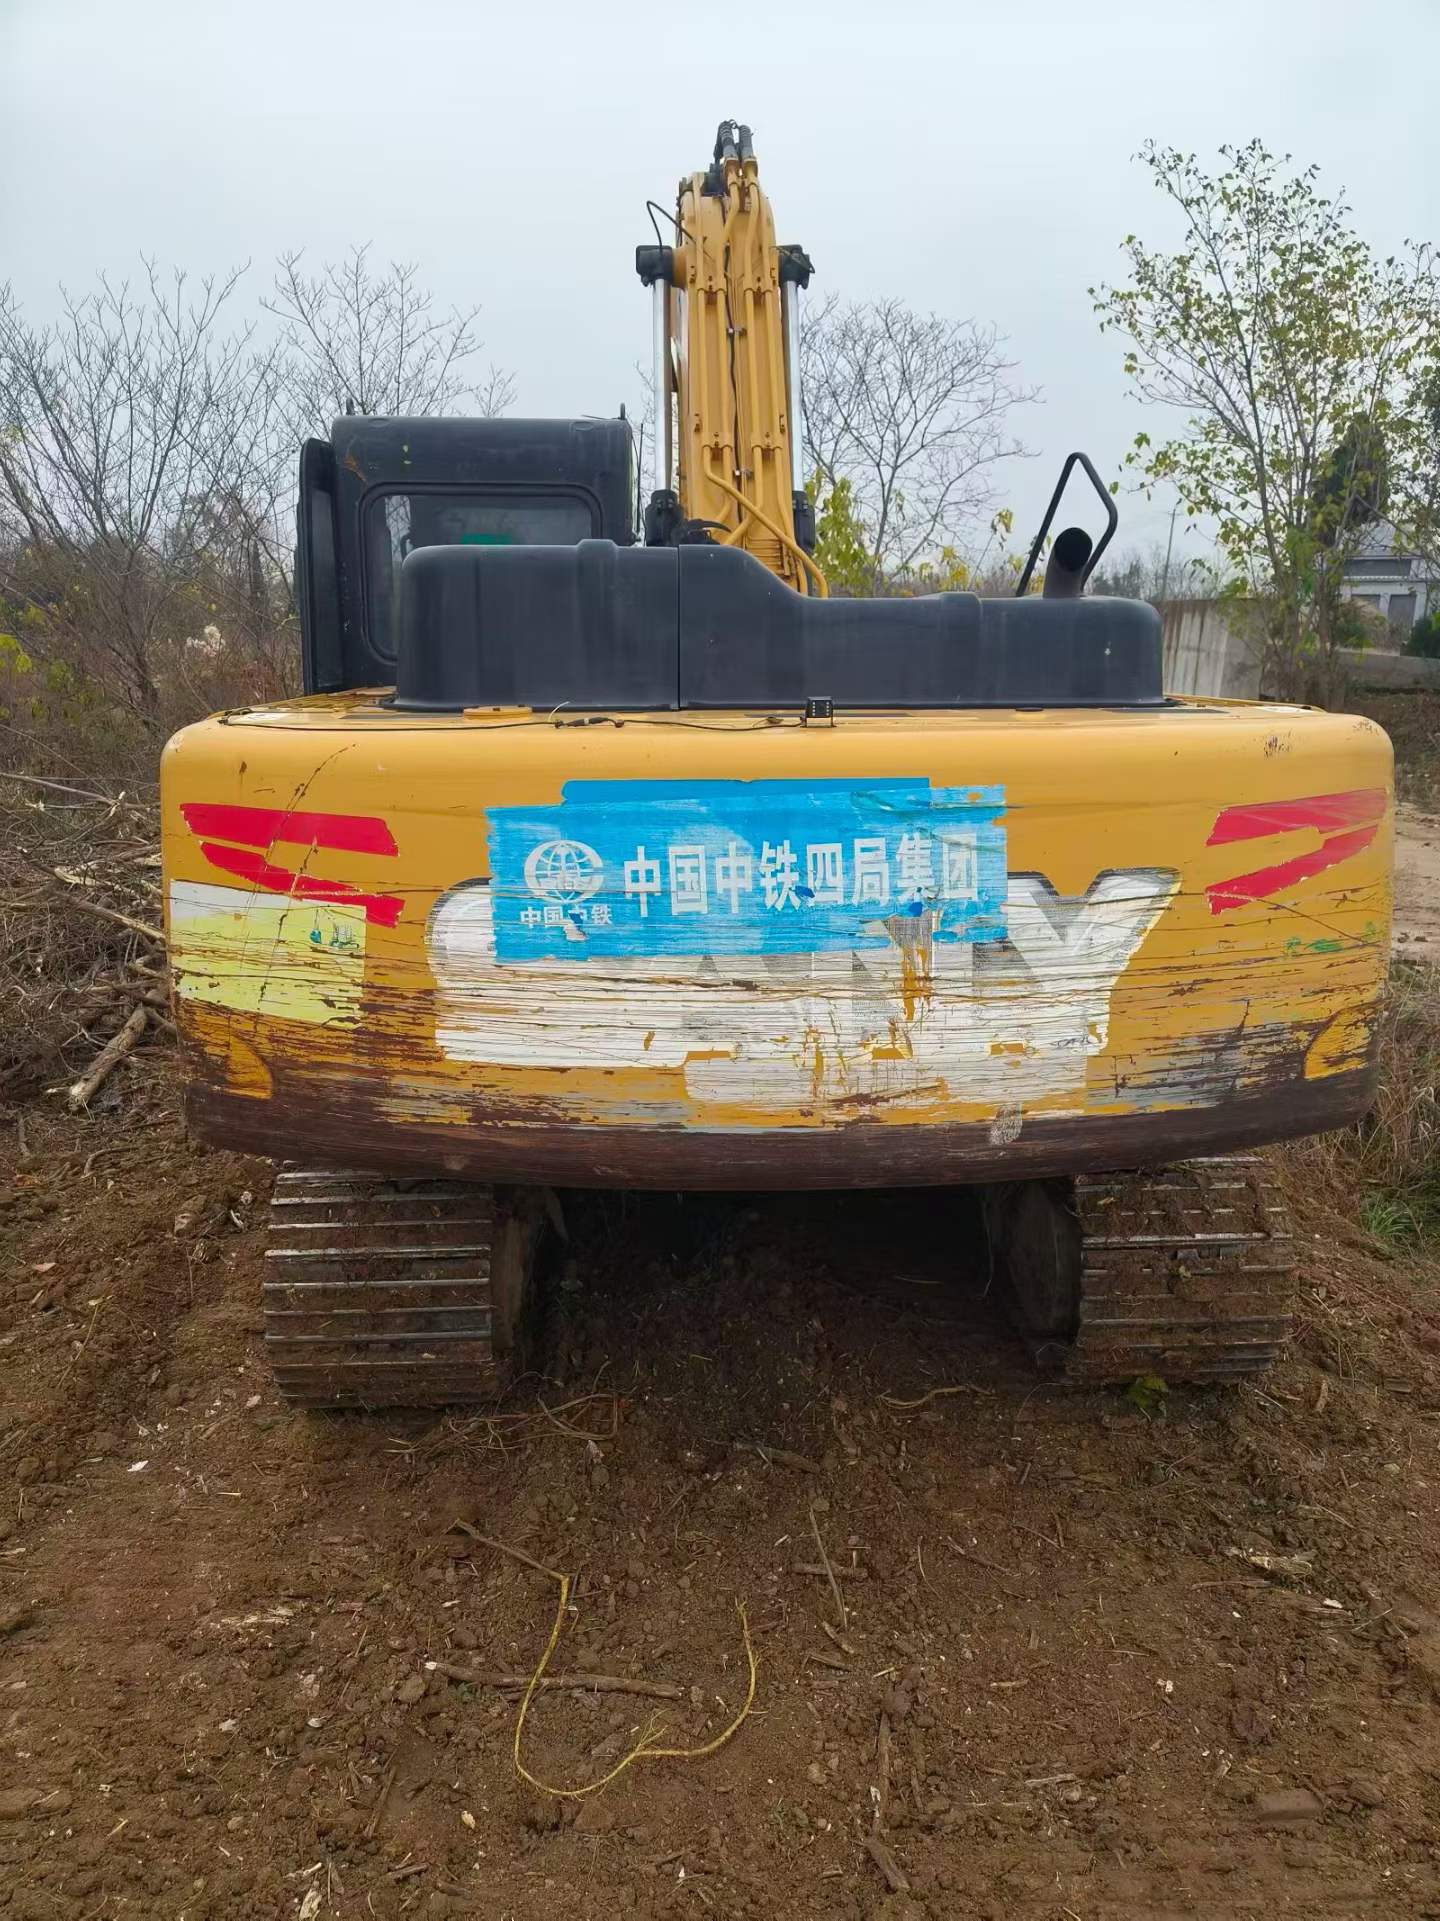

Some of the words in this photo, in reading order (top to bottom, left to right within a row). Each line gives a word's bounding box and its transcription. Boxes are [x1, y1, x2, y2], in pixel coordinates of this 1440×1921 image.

[624, 832, 979, 918] 中国中铁四局集团
